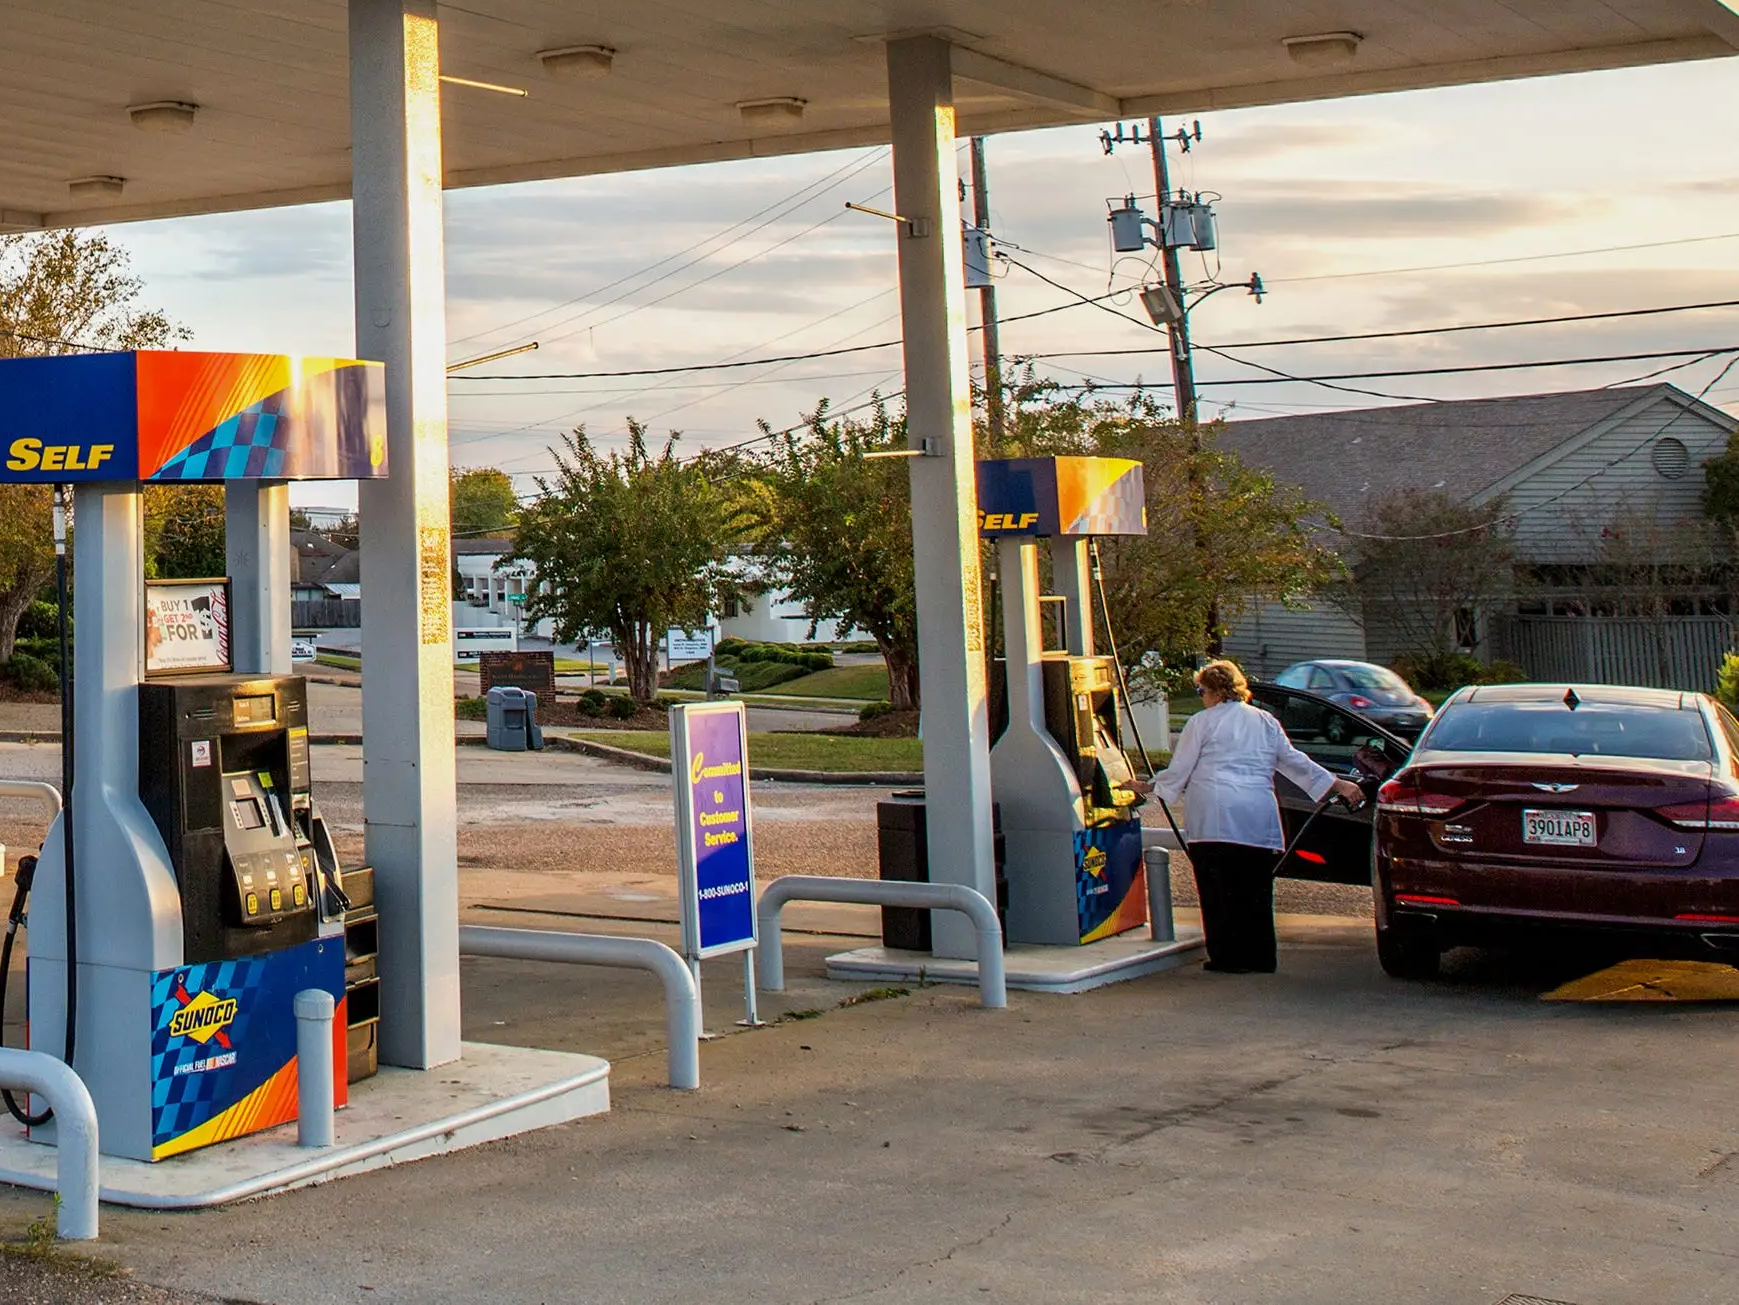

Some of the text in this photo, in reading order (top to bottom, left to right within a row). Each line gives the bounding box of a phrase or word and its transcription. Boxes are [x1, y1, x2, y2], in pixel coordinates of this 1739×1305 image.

[5, 437, 115, 471] SELF
[370, 434, 383, 466] 8
[161, 599, 190, 612] BUY 1
[163, 613, 179, 624] GET
[166, 623, 199, 641] FOR
[691, 752, 742, 785] Committed
[713, 790, 724, 805] to
[699, 809, 740, 827] Customer
[1528, 819, 1591, 838] 3901AP8
[704, 830, 739, 847] Service.
[697, 881, 750, 901] 1-800-SUNOCO-1
[172, 1002, 235, 1034] SUNOCO
